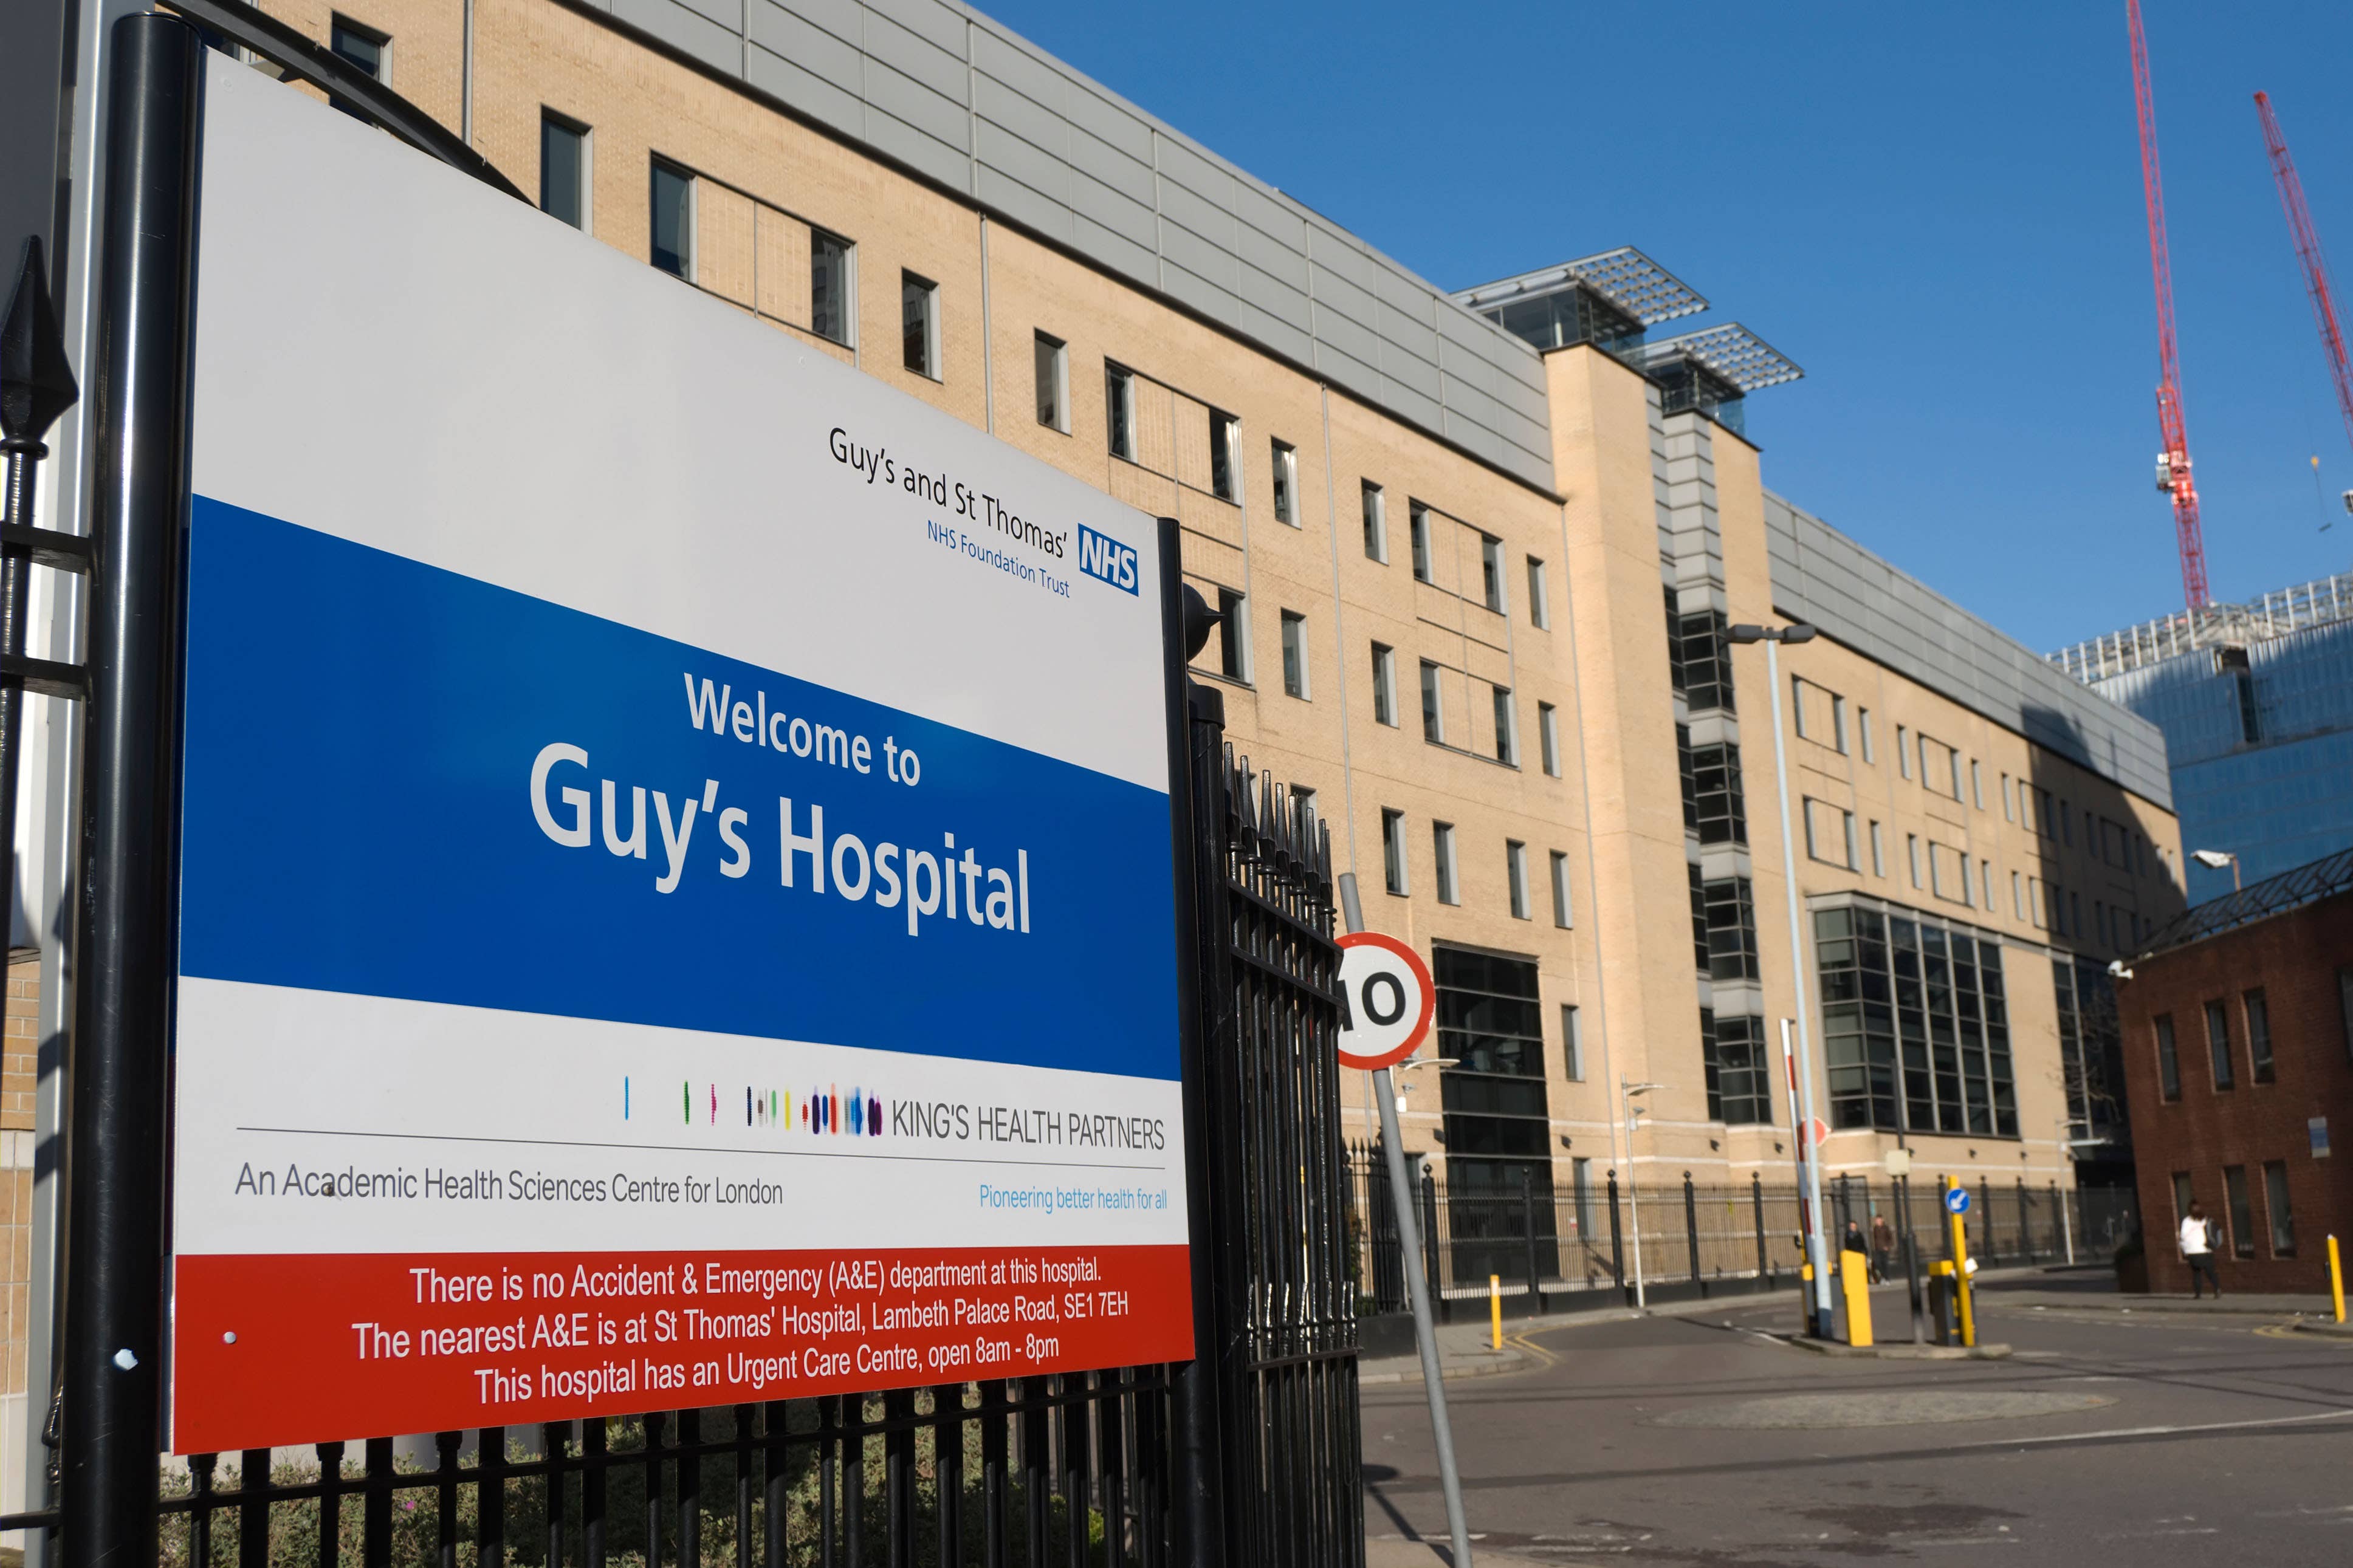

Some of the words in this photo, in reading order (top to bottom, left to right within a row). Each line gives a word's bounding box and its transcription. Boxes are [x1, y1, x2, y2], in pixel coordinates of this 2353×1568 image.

[830, 428, 895, 484] Guy's
[904, 468, 946, 507] and
[955, 483, 975, 520] St
[982, 494, 1067, 558] Thomas'
[928, 519, 957, 549] NHS
[961, 534, 1036, 584] Foundation
[1040, 568, 1069, 597] Trust
[1082, 530, 1135, 590] NHS
[684, 673, 871, 773] Welcome
[884, 736, 920, 786] to
[531, 743, 750, 893] Guy's
[780, 797, 1029, 936] Hospital
[893, 1100, 969, 1139] KING'S
[979, 1107, 1060, 1144] HEALTH
[1070, 1114, 1164, 1150] PARTNERS
[235, 1162, 275, 1195] An
[283, 1164, 417, 1198] Academic
[426, 1168, 502, 1199] Health
[509, 1170, 606, 1201] Sciences
[613, 1174, 679, 1202] Centre
[684, 1176, 710, 1203] for
[716, 1177, 782, 1204] London
[980, 1184, 1053, 1215] Pioneering
[1056, 1188, 1095, 1209] better
[1097, 1188, 1135, 1210] health
[1137, 1188, 1152, 1210] for
[1155, 1190, 1167, 1209] all
[410, 1268, 492, 1303] There
[503, 1267, 523, 1300] is
[534, 1273, 564, 1298] no
[571, 1264, 675, 1296] Accident
[682, 1263, 698, 1294] &
[707, 1263, 822, 1299] Emergency
[830, 1261, 884, 1297] (A&E)
[890, 1260, 986, 1294] department
[991, 1259, 1006, 1284] at
[1010, 1258, 1037, 1284] this
[1042, 1256, 1101, 1288] hospital.
[352, 1323, 410, 1359] The
[421, 1317, 525, 1355] nearest
[532, 1313, 588, 1348] A&E
[599, 1313, 616, 1344] is
[625, 1312, 647, 1343] at
[655, 1310, 677, 1341] St
[684, 1306, 774, 1340] Thomas'
[783, 1303, 865, 1340] Hospital,
[873, 1299, 948, 1330] Lambeth
[955, 1298, 1009, 1325] Palace
[1015, 1295, 1059, 1323] Road,
[1065, 1293, 1092, 1318] SE1
[1099, 1291, 1128, 1316] 7EH
[475, 1368, 532, 1403] This
[542, 1359, 635, 1402] hospital
[645, 1358, 685, 1389] has
[693, 1362, 719, 1386] an
[728, 1351, 797, 1389] Urgent
[804, 1347, 850, 1377] Care
[857, 1343, 922, 1373] Centre,
[929, 1344, 970, 1373] open
[976, 1337, 1010, 1363] 8am
[1026, 1333, 1059, 1364] 8pm
